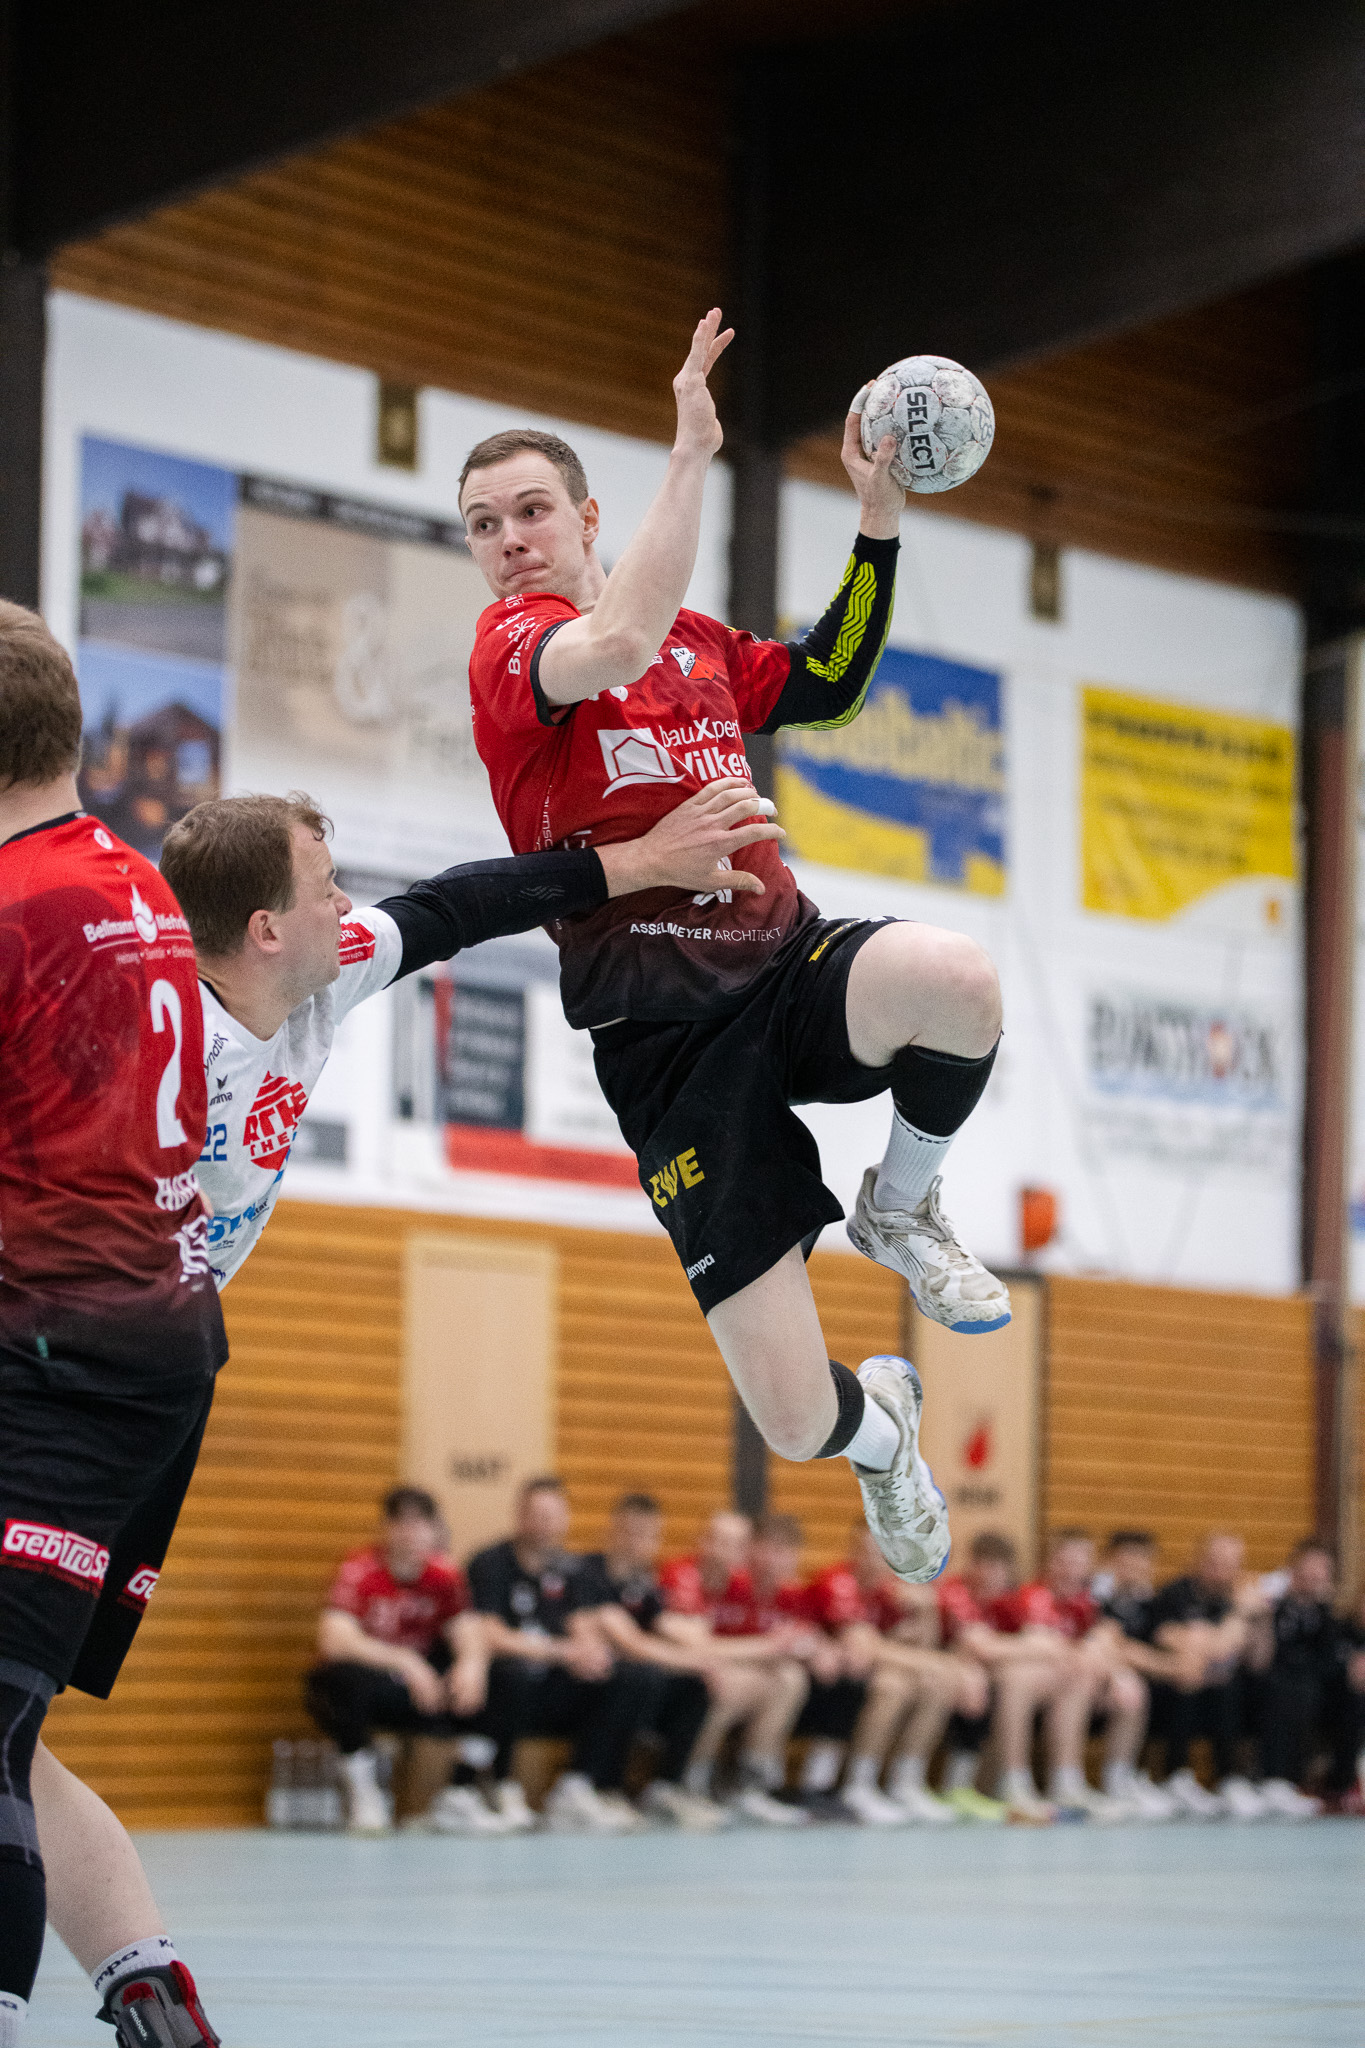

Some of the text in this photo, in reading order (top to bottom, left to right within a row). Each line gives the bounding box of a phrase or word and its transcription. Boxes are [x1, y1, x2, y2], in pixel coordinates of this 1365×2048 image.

[906, 391, 936, 470] SELECT
[658, 716, 742, 748] bauXpert
[629, 921, 781, 942] ASSELMEYER ARCHITEKT
[150, 978, 189, 1149] 2
[649, 1147, 706, 1208] EWE
[686, 1253, 716, 1281] empa
